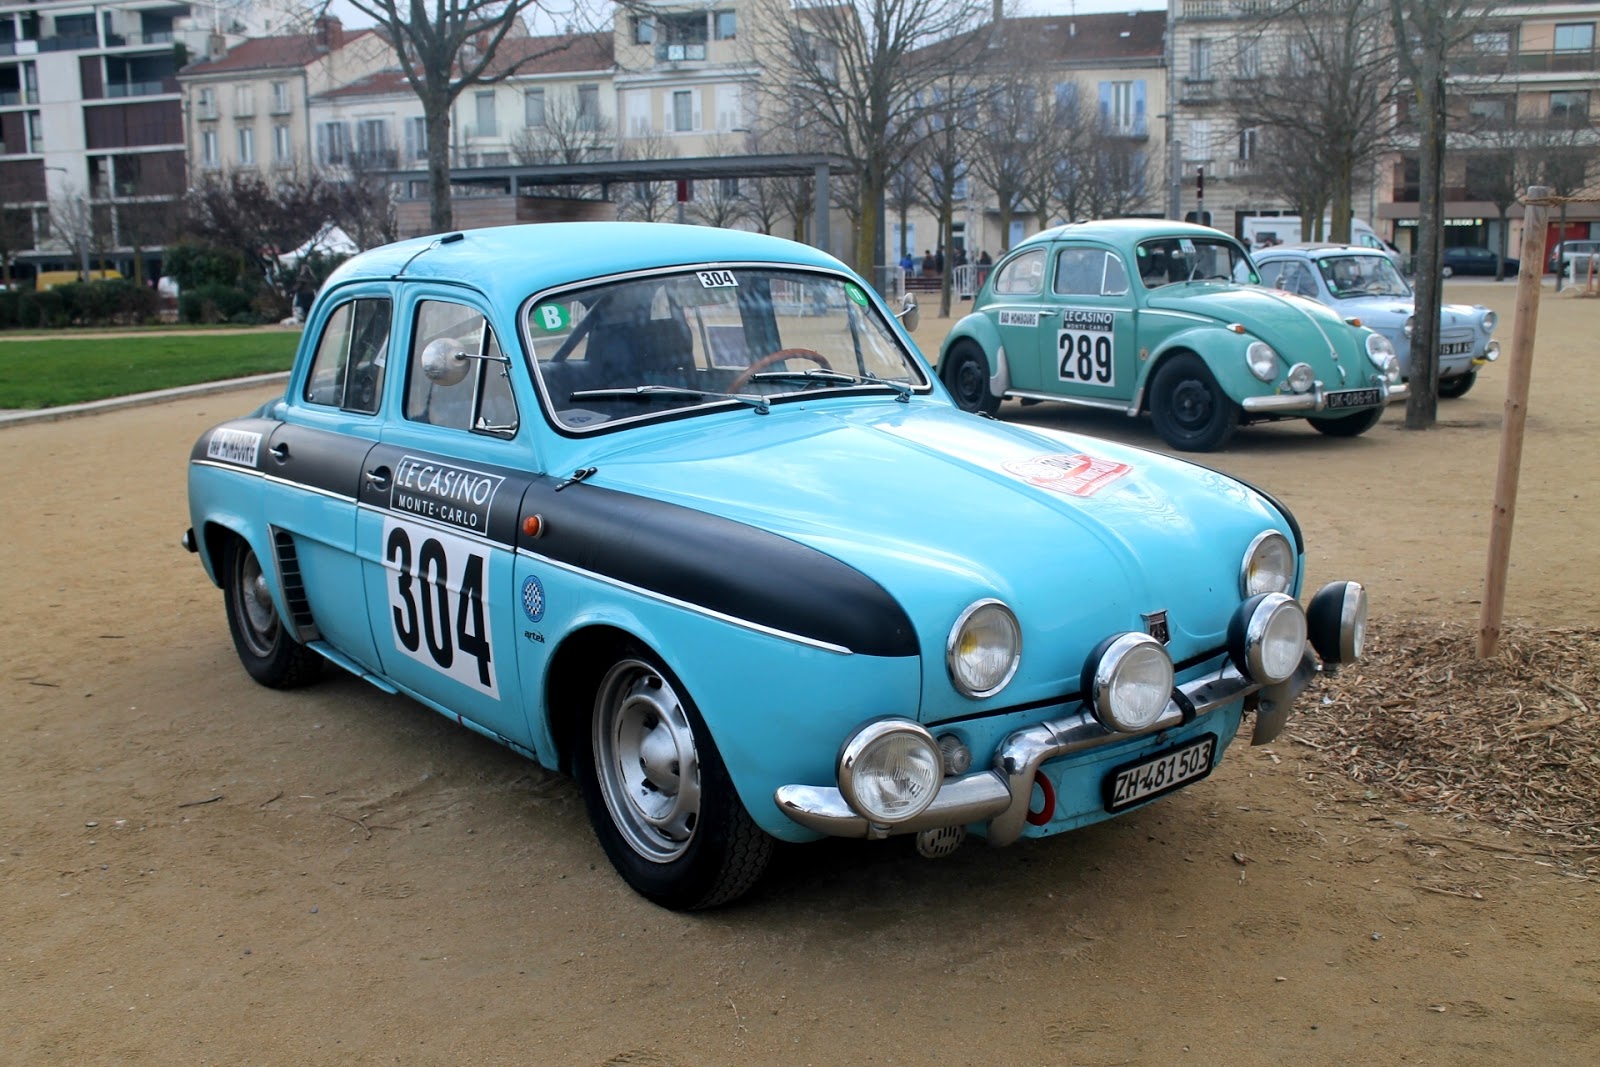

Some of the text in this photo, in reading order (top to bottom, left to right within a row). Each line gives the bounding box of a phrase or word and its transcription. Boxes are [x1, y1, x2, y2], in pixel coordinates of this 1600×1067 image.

[700, 271, 734, 286] 304
[541, 305, 561, 330] B
[1060, 333, 1112, 384] 289
[417, 466, 491, 505] CASINO
[387, 527, 491, 687] 304
[525, 630, 545, 644] artek
